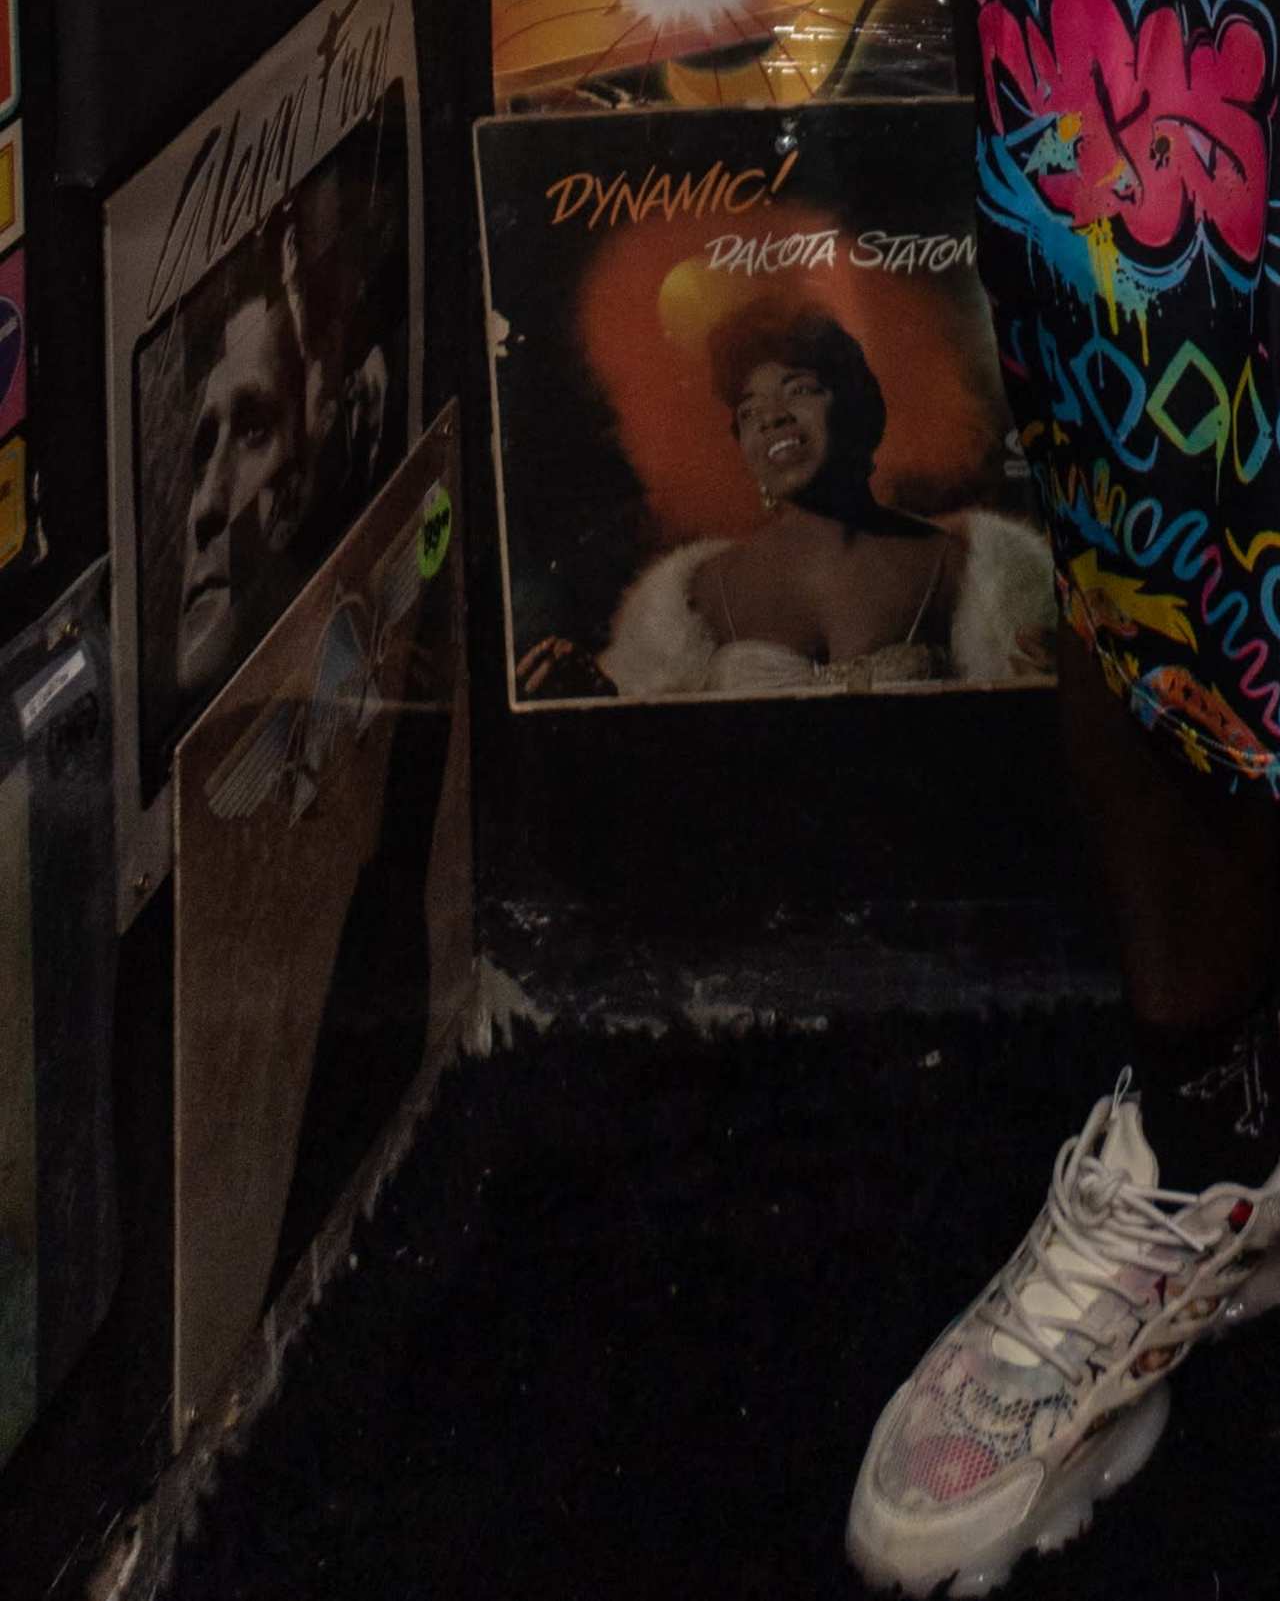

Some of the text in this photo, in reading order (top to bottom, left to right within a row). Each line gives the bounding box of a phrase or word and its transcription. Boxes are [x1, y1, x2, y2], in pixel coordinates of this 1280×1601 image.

[545, 151, 800, 229] DYNAMIC!
[703, 229, 977, 277] DAKOTA STATON
